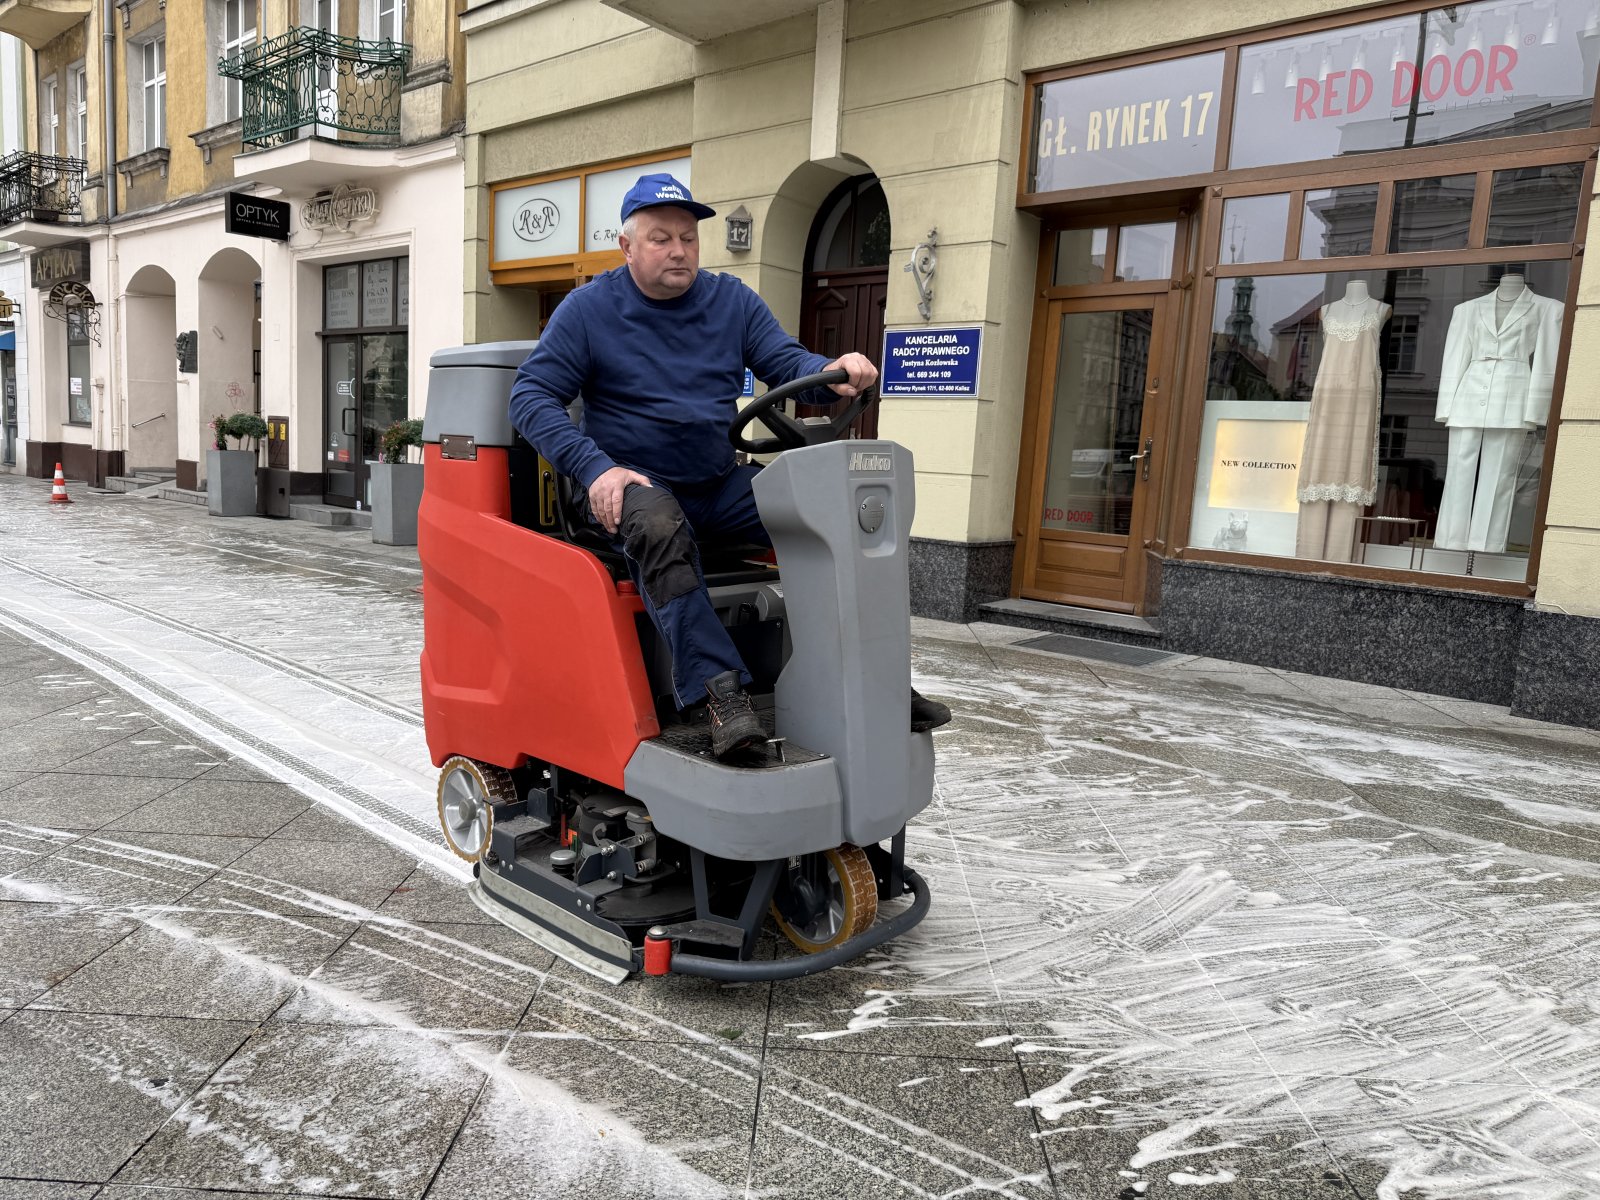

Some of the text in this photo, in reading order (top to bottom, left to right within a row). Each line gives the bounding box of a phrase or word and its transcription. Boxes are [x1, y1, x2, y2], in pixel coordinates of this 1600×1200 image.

[1293, 44, 1519, 122] RED DOOR
[1038, 91, 1214, 158] GŁ. RYNEK 17
[236, 203, 280, 224] OPTYK
[604, 228, 620, 242] Ryd
[730, 227, 748, 243] 17
[36, 252, 76, 281] APTEKA
[50, 282, 96, 309] APTEKA
[905, 335, 958, 345] KANCELARIA
[892, 345, 970, 357] RADCY PRAWNEGO
[900, 360, 924, 368] Justyna
[940, 370, 952, 378] 109
[848, 453, 891, 471] Hako
[1242, 461, 1297, 470] COLLECTION
[1045, 508, 1094, 523] RED DOOR
